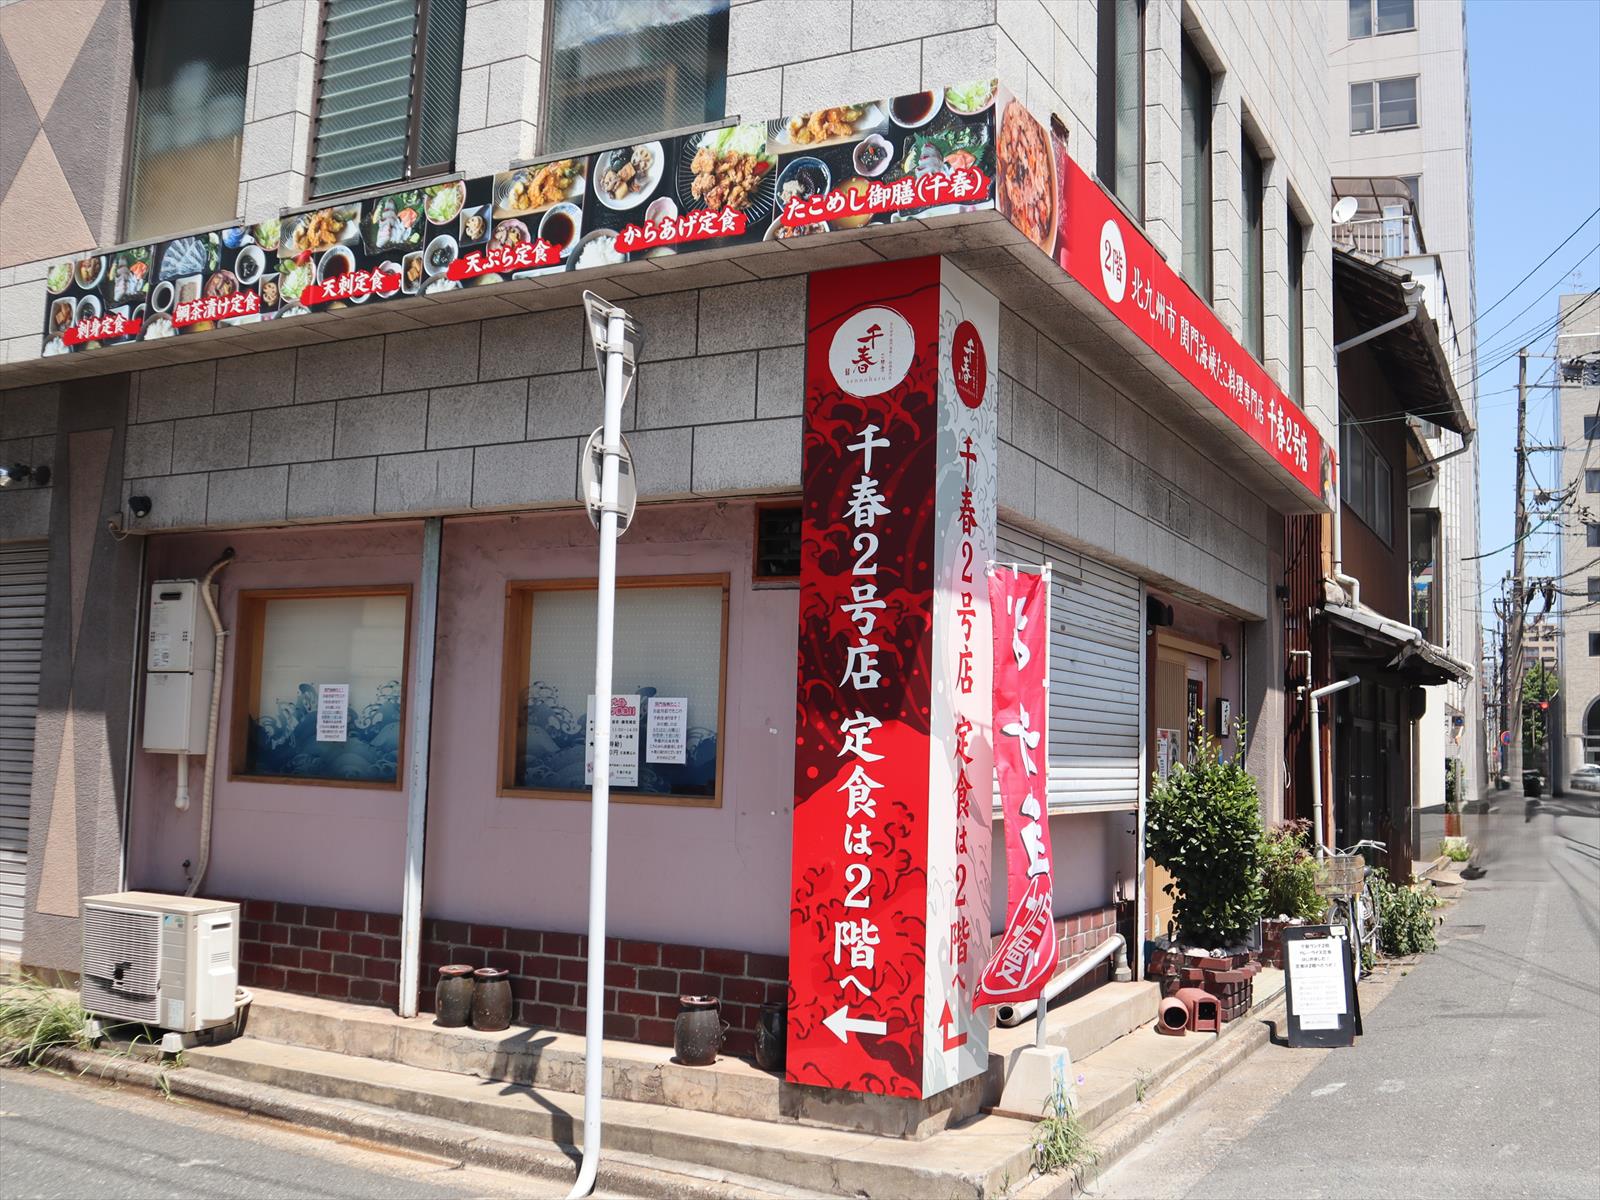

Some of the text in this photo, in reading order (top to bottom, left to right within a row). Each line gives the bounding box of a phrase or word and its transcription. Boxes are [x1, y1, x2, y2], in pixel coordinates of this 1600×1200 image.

[787, 169, 985, 219] たこめし御膳(千春)
[623, 210, 741, 244] からあげ定食
[465, 241, 550, 274] 天ぷら定食
[1103, 239, 1123, 284] 2階
[321, 270, 385, 298] 天刺定食
[76, 315, 128, 339] 刺身定食
[852, 323, 884, 374] 千春
[1131, 266, 1308, 472] 北九州市 関門海峡たこ料理専門店 千春2号店
[833, 424, 891, 997] 千春2号店 定食は2階へ
[949, 436, 978, 990] 千春2号店 定食は2階へ
